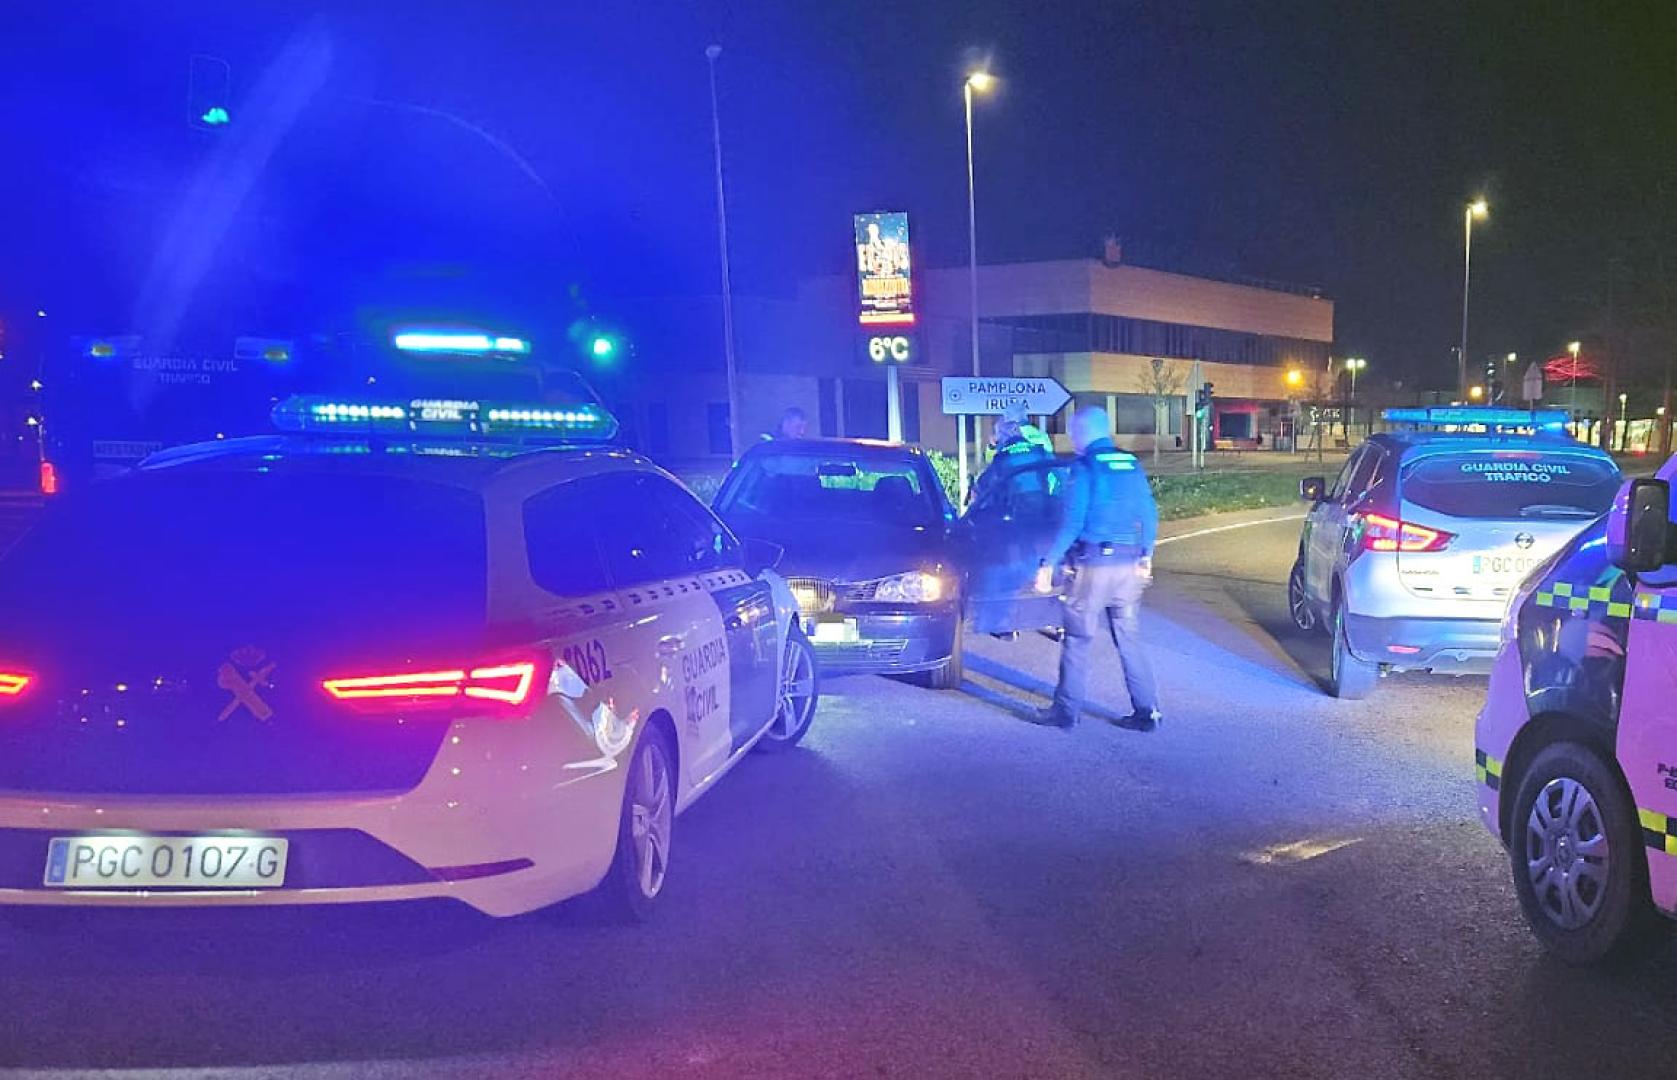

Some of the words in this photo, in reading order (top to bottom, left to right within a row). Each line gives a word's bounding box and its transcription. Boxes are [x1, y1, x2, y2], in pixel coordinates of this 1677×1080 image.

[133, 357, 197, 370] GUARDIA
[202, 358, 239, 371] CIVIL
[969, 382, 1046, 394] PAMPLONA
[410, 399, 479, 410] GUARDIA
[421, 408, 463, 420] CIVIL
[1460, 462, 1529, 473] GUARDIA
[1531, 463, 1571, 474] CIVIL
[1484, 472, 1551, 482] TRAFICO
[682, 637, 726, 683] GUARDIA
[696, 685, 720, 722] CIVIL
